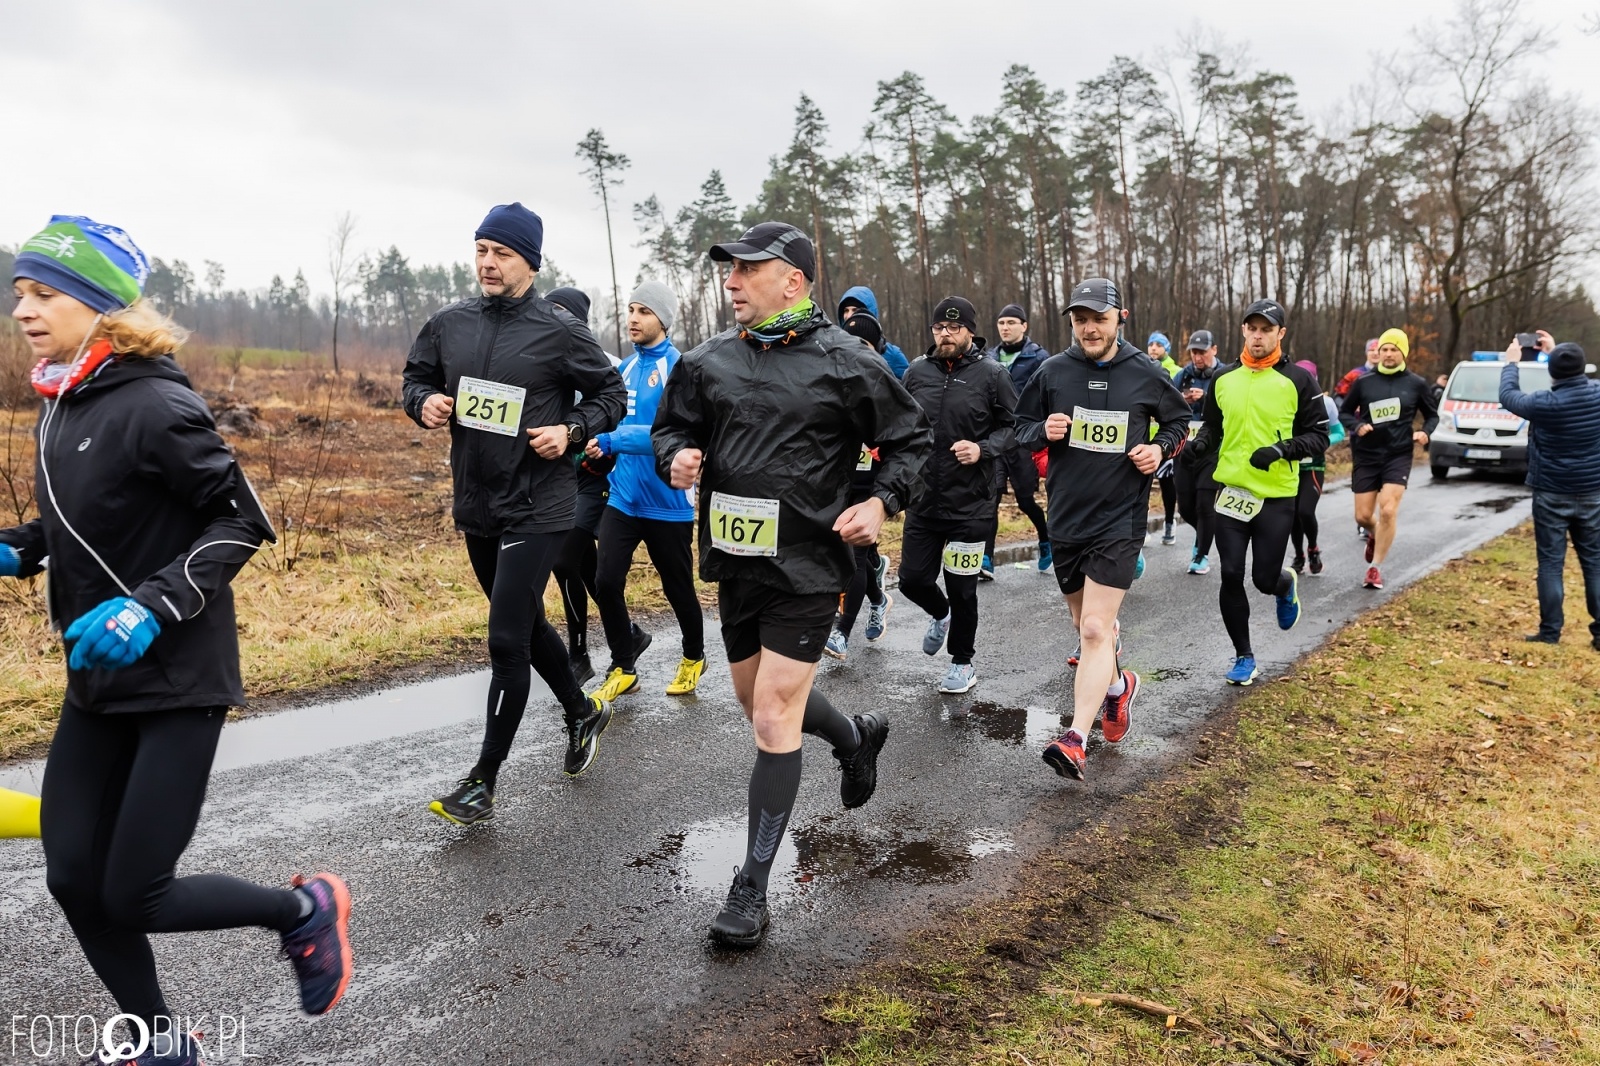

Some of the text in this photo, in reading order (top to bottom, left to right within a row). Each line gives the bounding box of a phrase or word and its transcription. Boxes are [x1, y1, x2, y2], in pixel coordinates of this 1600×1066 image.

[465, 395, 508, 423] 251
[1375, 406, 1397, 418] 202
[1081, 422, 1118, 444] 189
[1223, 495, 1255, 515] 245
[718, 514, 765, 543] 167
[951, 552, 979, 568] 183
